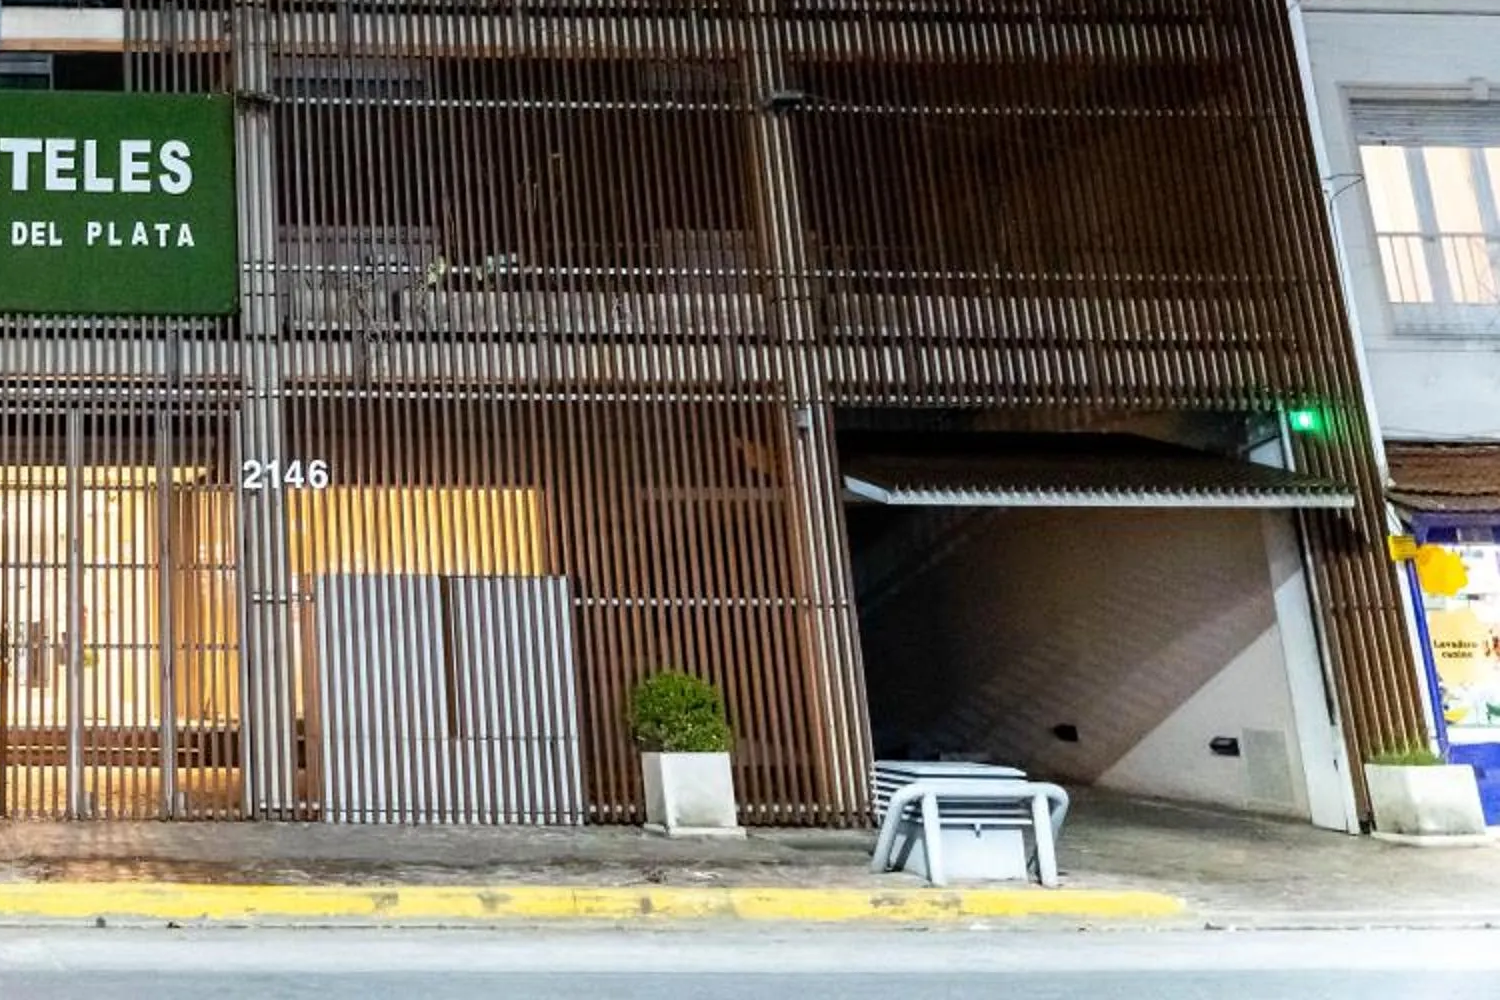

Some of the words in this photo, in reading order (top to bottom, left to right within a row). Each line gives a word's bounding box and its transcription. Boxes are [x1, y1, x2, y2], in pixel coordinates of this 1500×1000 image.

[11, 221, 63, 247] DEL
[87, 221, 195, 248] PLATA
[243, 459, 329, 489] 2146
